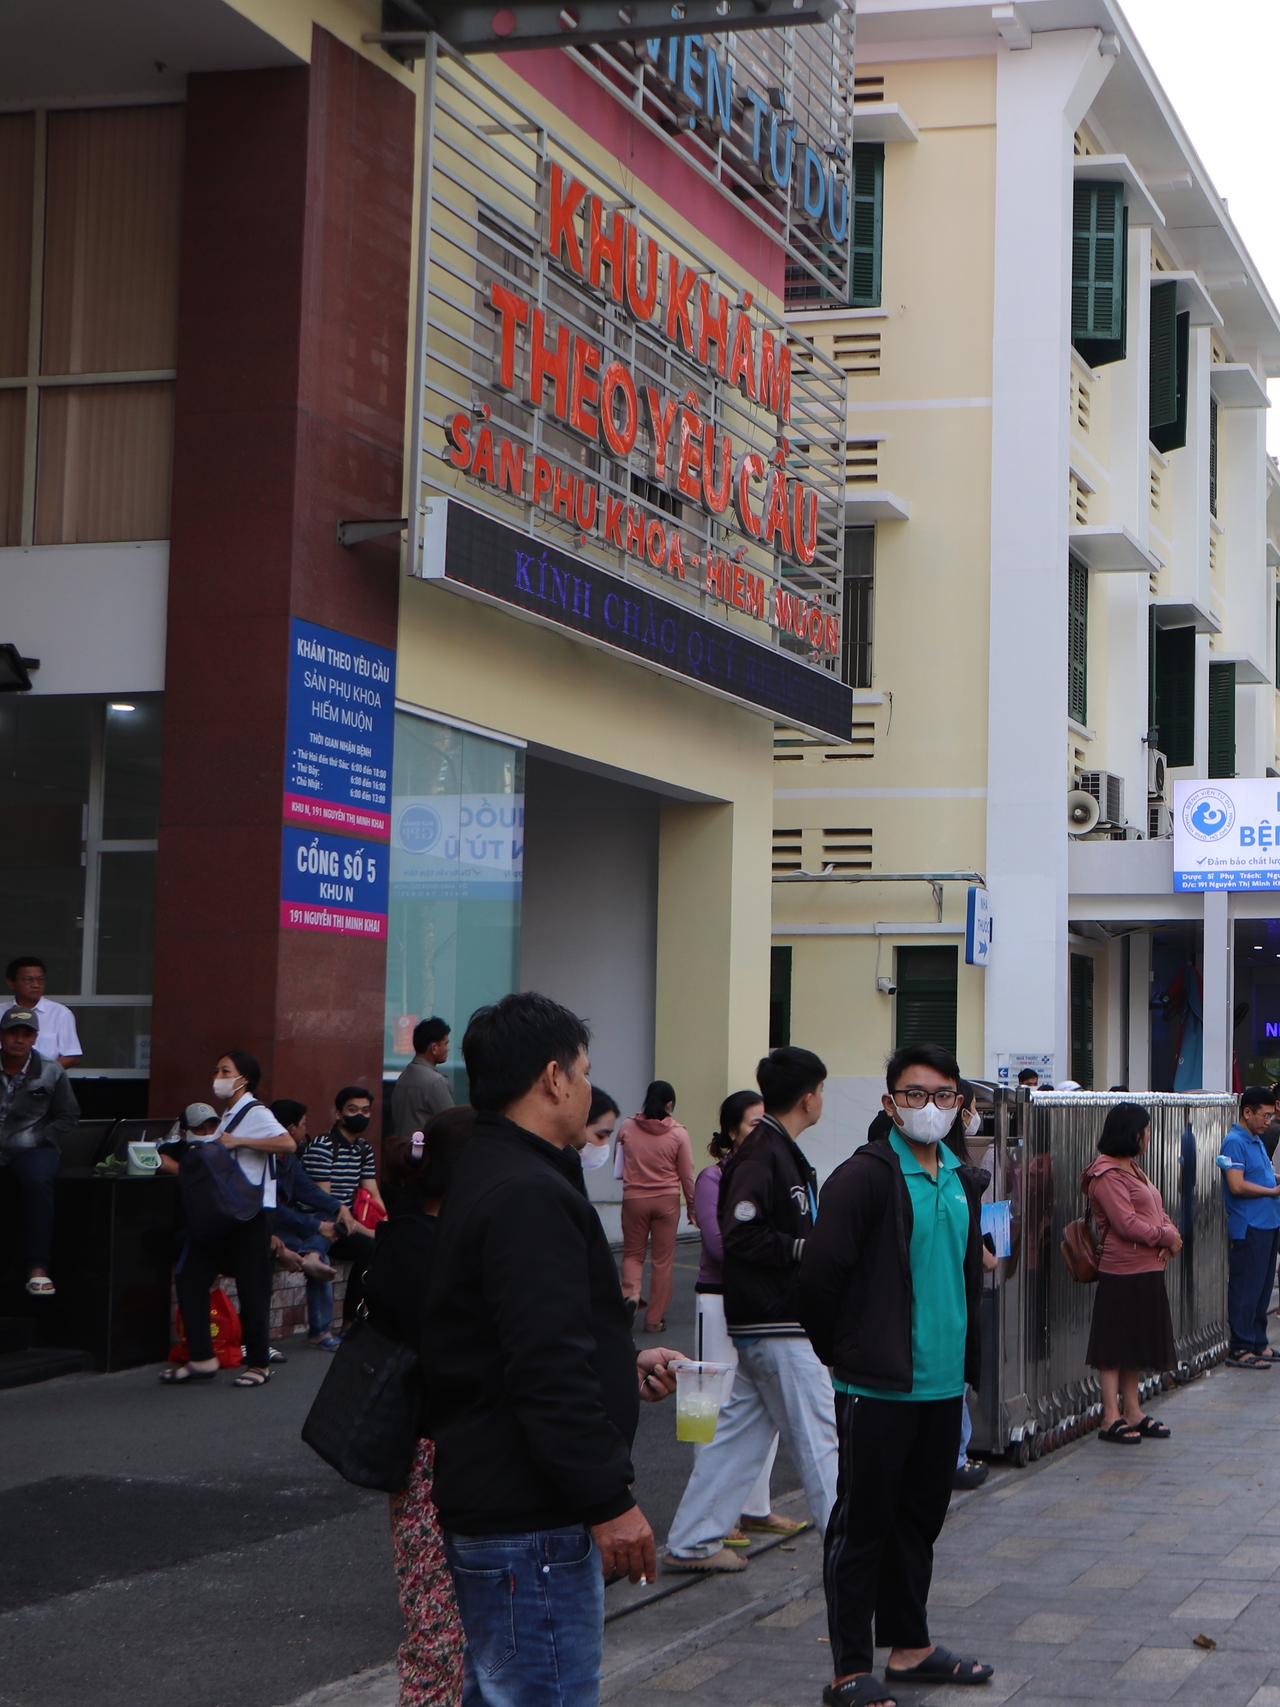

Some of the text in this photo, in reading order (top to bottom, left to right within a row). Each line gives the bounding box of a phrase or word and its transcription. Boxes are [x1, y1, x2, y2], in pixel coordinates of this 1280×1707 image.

[748, 88, 797, 188] TỪ
[804, 146, 847, 243] DŨ
[549, 161, 791, 424] KHU KHÁM
[491, 282, 818, 565] THEO YÊU CẦU
[449, 403, 523, 496] SẢN
[533, 455, 596, 548] PHỤ
[604, 494, 686, 580] KHOA
[707, 546, 765, 619] HIẾM
[774, 588, 839, 661] MUỘN
[514, 549, 592, 619] KÍNH
[603, 593, 679, 655] CHÀO
[687, 631, 739, 680] QUÝ
[297, 638, 390, 683] KHÁM THEO YÊU CẦU
[304, 668, 382, 709] SẢN PHỤ KHOA
[312, 700, 373, 732] HIẾM MUỘN
[309, 732, 372, 757] THỜI GIAN NHẬN BỆNH
[297, 762, 307, 773] Thứ
[350, 775, 362, 786] 6:00
[362, 778, 372, 788] đến
[372, 781, 386, 791] 16:00
[298, 749, 308, 760] Thứ
[308, 751, 318, 761] Hai
[318, 754, 328, 764] đến
[329, 757, 338, 766] thứ
[351, 762, 362, 773] 6:00
[363, 765, 372, 776] đến
[373, 767, 387, 779] 18:00
[296, 776, 307, 786] Chủ
[308, 779, 320, 791] Nhật
[350, 788, 361, 799] 6:00
[361, 791, 371, 801] đến
[372, 794, 386, 804] 13:00
[291, 802, 304, 812] KHU
[312, 806, 322, 816] 191
[346, 813, 356, 825] THỊ
[356, 815, 370, 826] MINH
[371, 819, 384, 829] KHAI
[297, 837, 376, 883] CỔNG SỐ 5
[1207, 857, 1228, 866] Đảm
[1229, 857, 1246, 865] bảo
[1248, 856, 1267, 865] chất
[320, 882, 354, 902] KHU N
[1182, 873, 1202, 881] Dược
[1209, 880, 1237, 888] Nguyễn
[290, 909, 380, 933] 191 NGUYỄN THỊ MINH KHAI
